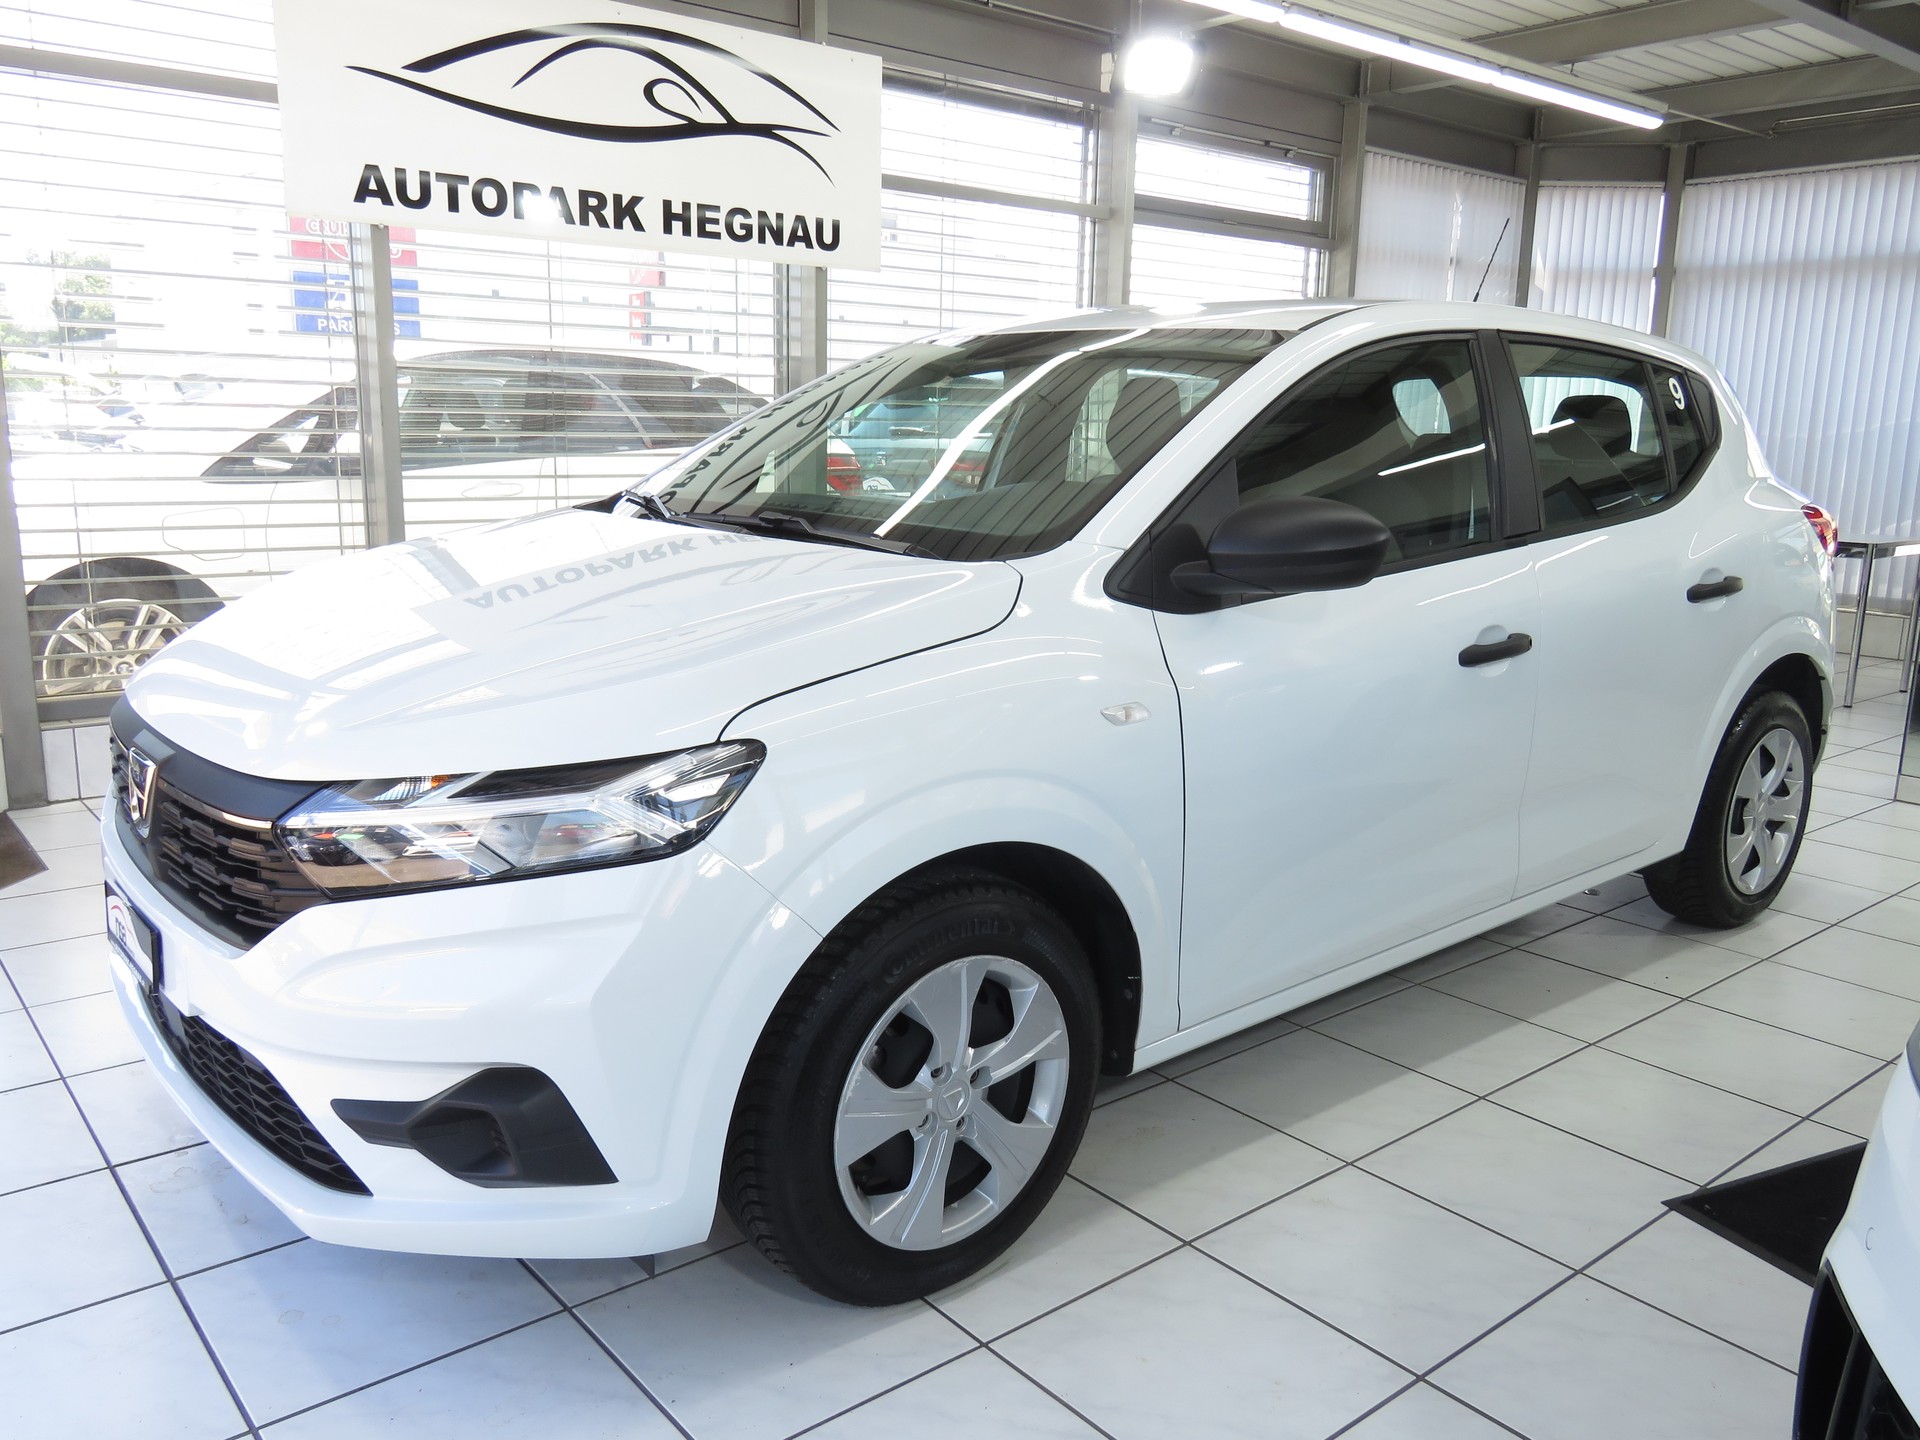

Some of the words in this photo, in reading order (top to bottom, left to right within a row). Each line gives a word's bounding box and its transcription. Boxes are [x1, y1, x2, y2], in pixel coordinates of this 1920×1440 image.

[353, 163, 646, 233] AUTOPARK
[662, 199, 841, 252] HEGNAU
[1668, 377, 1685, 410] 9
